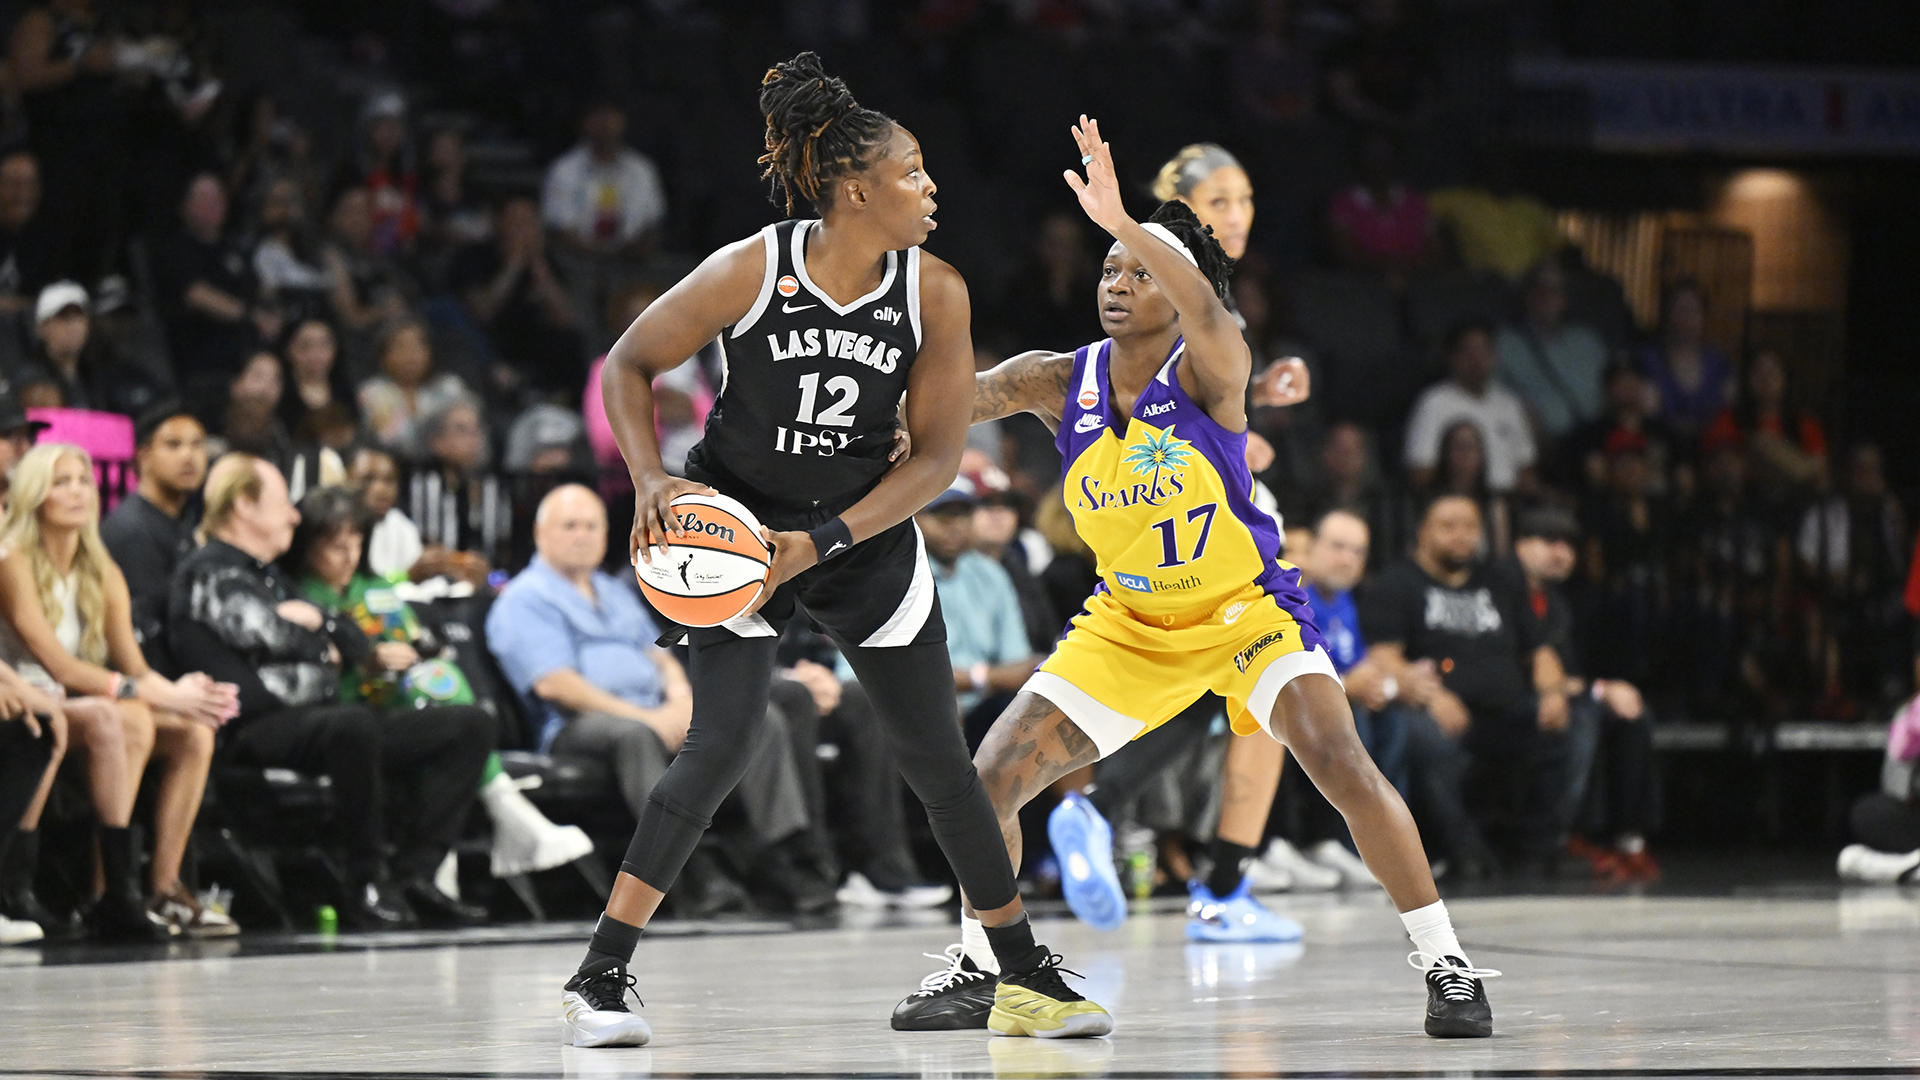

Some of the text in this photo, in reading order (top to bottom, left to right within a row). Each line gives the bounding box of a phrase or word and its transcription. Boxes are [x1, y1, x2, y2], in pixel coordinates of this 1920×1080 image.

[873, 306, 902, 326] ally
[767, 328, 902, 374] LAS VEGAS
[795, 372, 860, 427] 12
[1142, 400, 1177, 418] Albert
[1080, 412, 1104, 427] NIKE
[774, 426, 864, 457] IPSY
[1151, 502, 1218, 569] 17
[1118, 575, 1202, 592] UCLA Health
[1225, 601, 1244, 618] NIKE
[1244, 632, 1283, 662] WNBA
